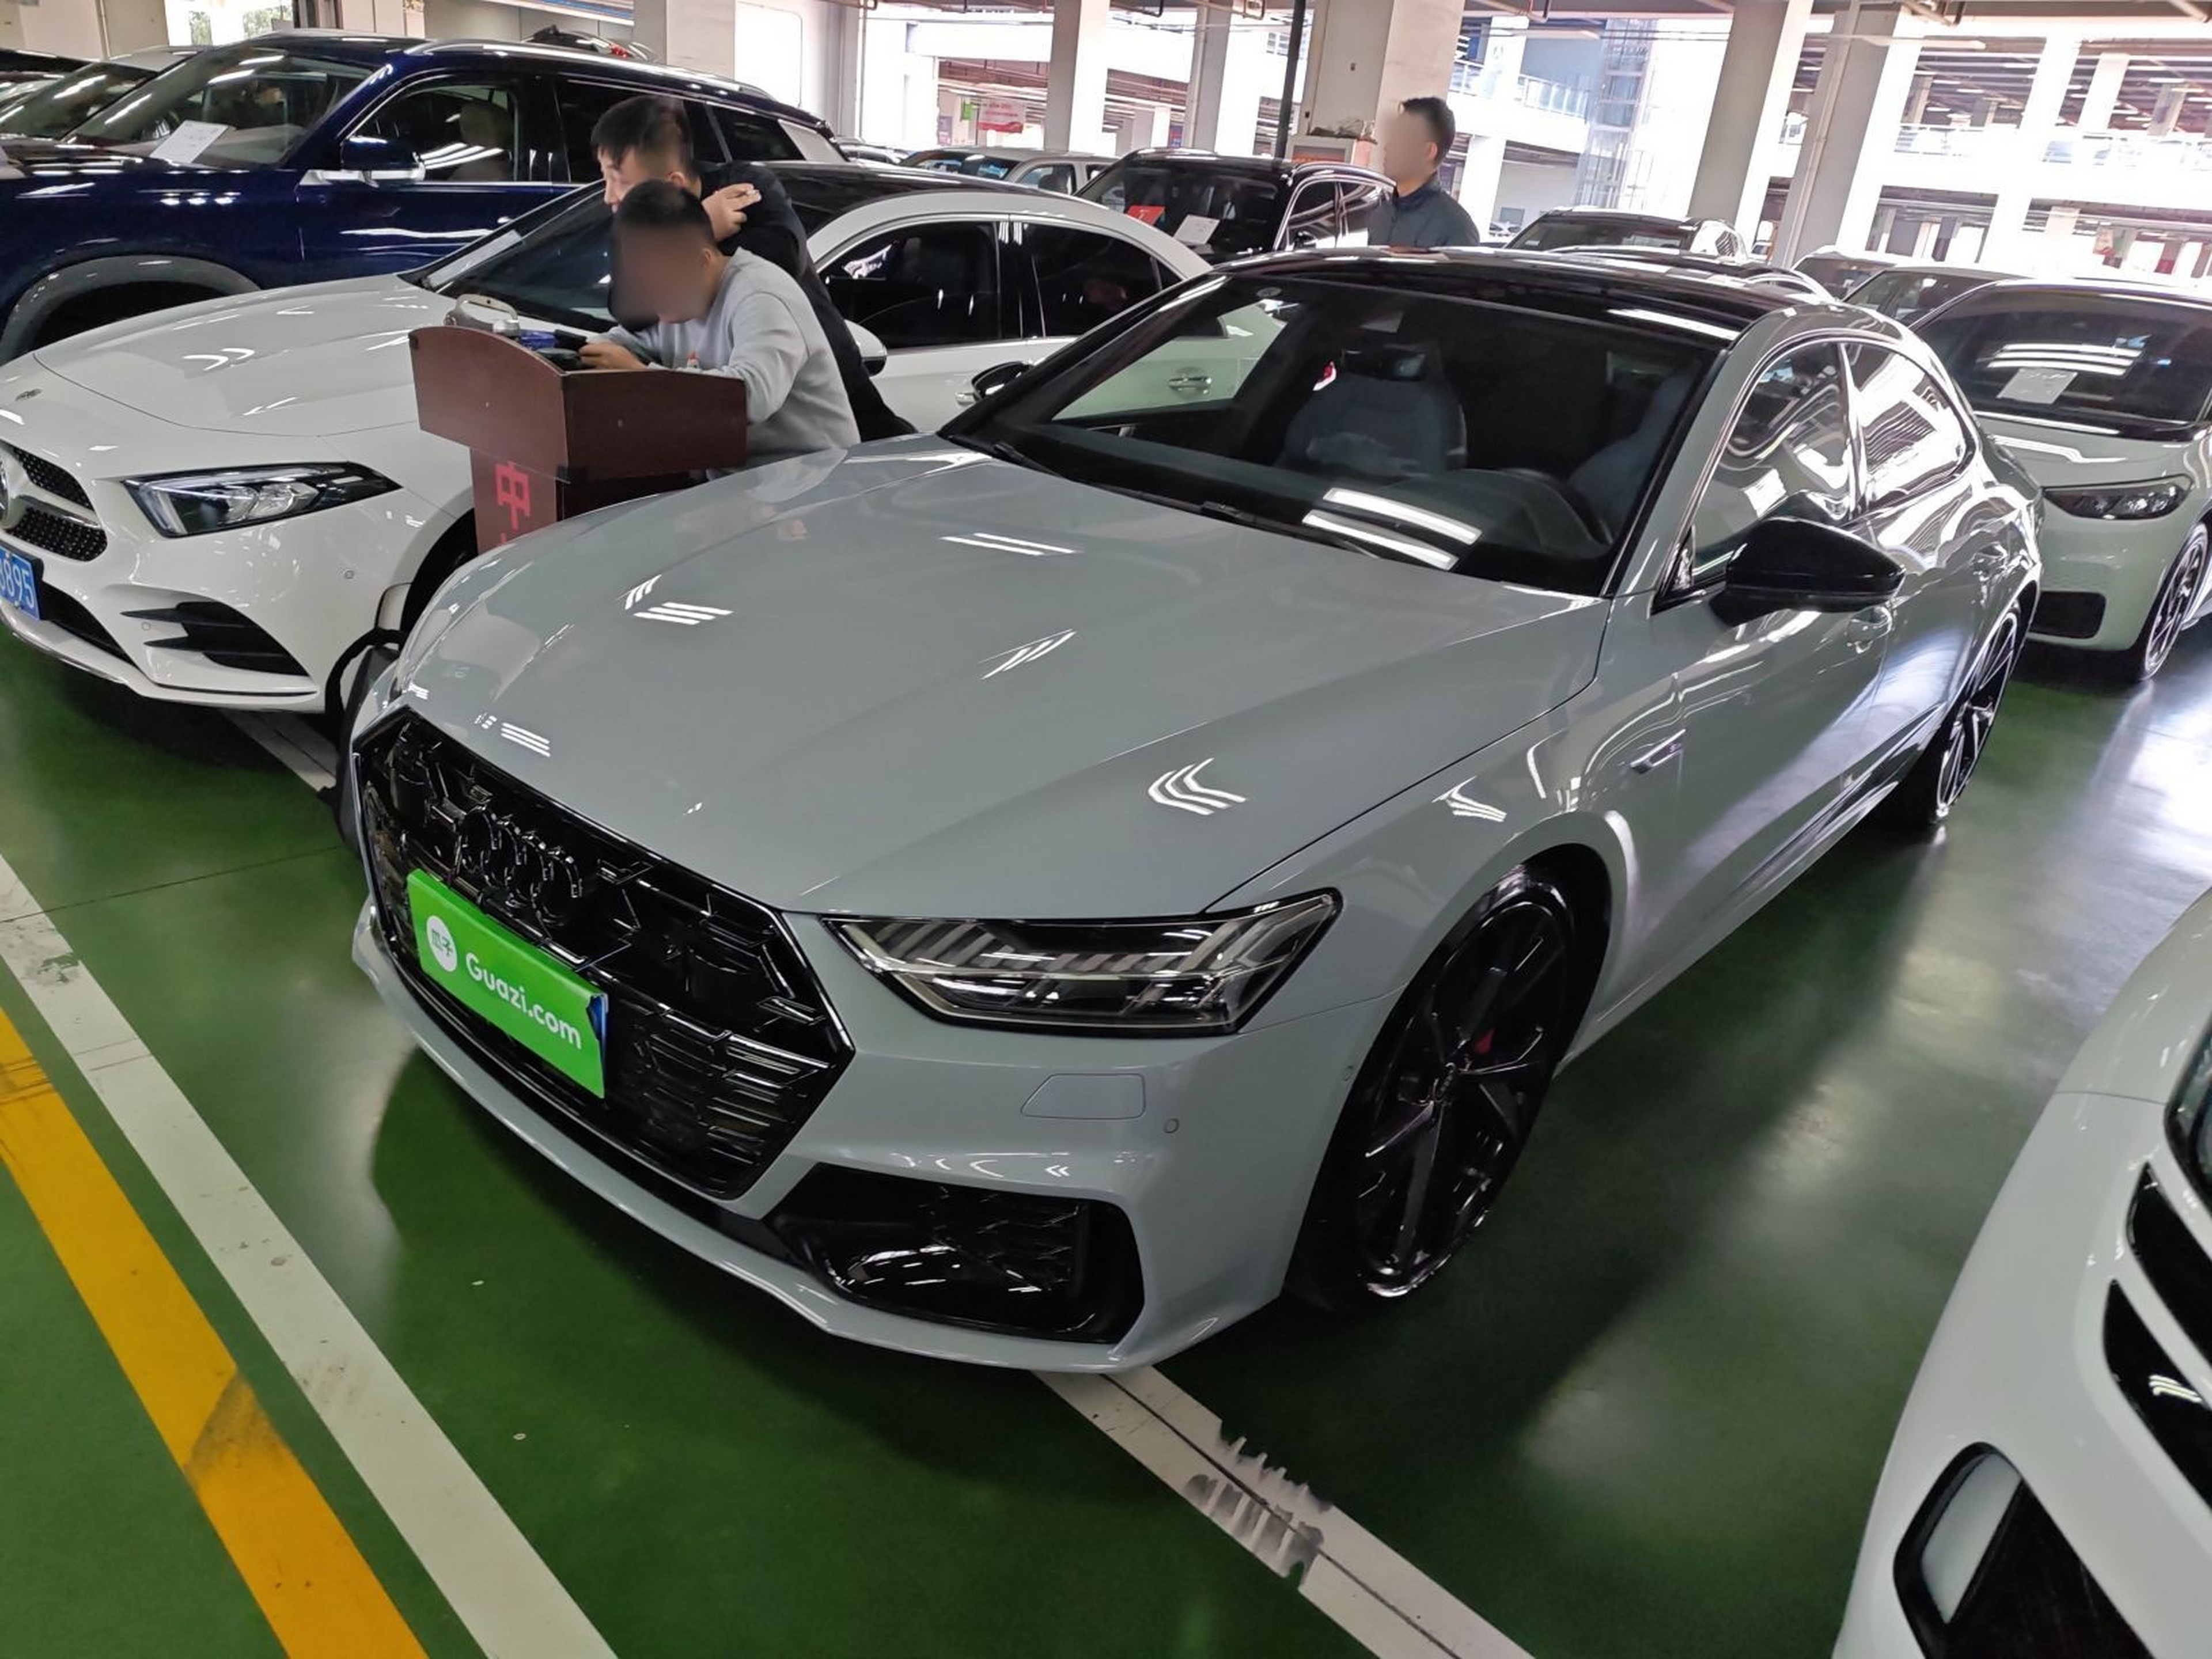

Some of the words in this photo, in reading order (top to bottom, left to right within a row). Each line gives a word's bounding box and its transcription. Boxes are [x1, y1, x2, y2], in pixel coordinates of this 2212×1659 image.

[495, 461, 531, 544] 中
[431, 927, 453, 957] 瓜子
[466, 952, 582, 1050] Guazi.com
